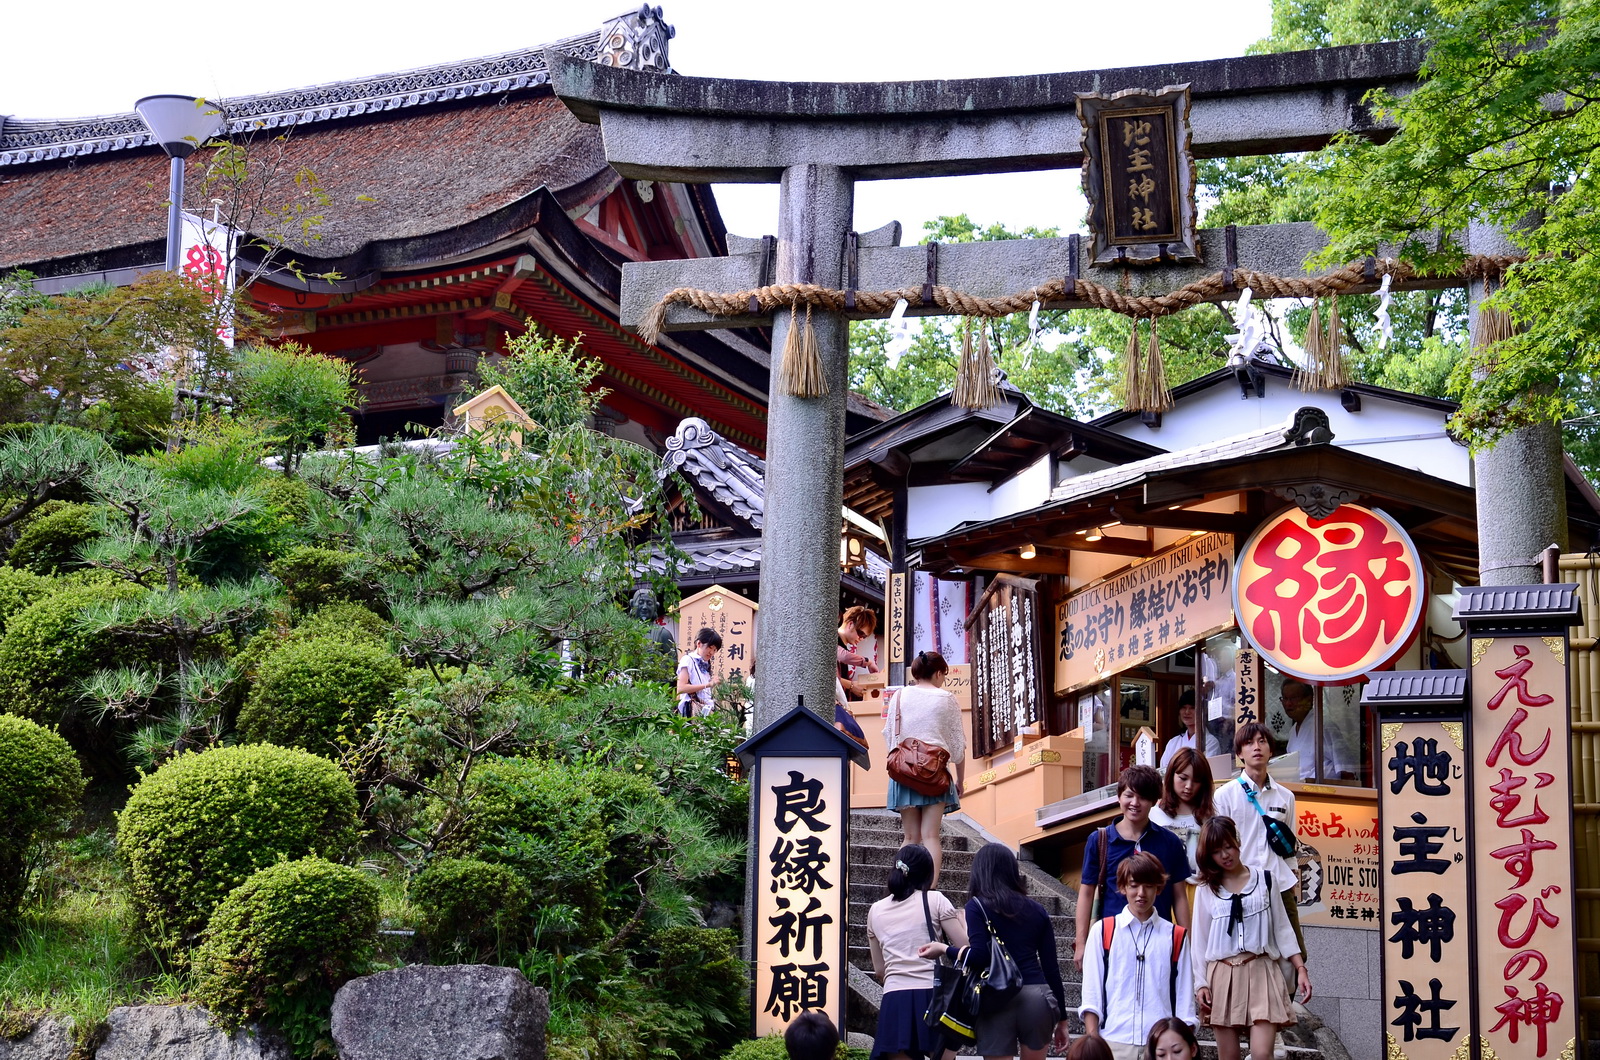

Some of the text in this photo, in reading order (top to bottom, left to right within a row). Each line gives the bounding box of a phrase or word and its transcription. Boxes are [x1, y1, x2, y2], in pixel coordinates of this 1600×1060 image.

[1123, 120, 1157, 230] 地主神社
[891, 577, 903, 659] 恋占いおみくじ
[1059, 533, 1230, 622] GOOD LUCK CHARMS KYOTO JISHU SHRINE
[1060, 600, 1125, 662] 恋のお守り
[1129, 552, 1229, 630] 縁結びお守り
[1246, 505, 1412, 668] 縁
[1108, 613, 1187, 663] 京都地主神社
[1237, 651, 1257, 723] 恋占いおみ
[1327, 855, 1342, 863] Here
[1353, 857, 1365, 865] the
[1328, 865, 1379, 889] LOVE STO
[1388, 736, 1461, 1043] 地主神社
[1486, 644, 1565, 1058] えんむすびの神
[764, 770, 834, 1023] 良縁祈願
[1330, 888, 1379, 904] えんむすびの
